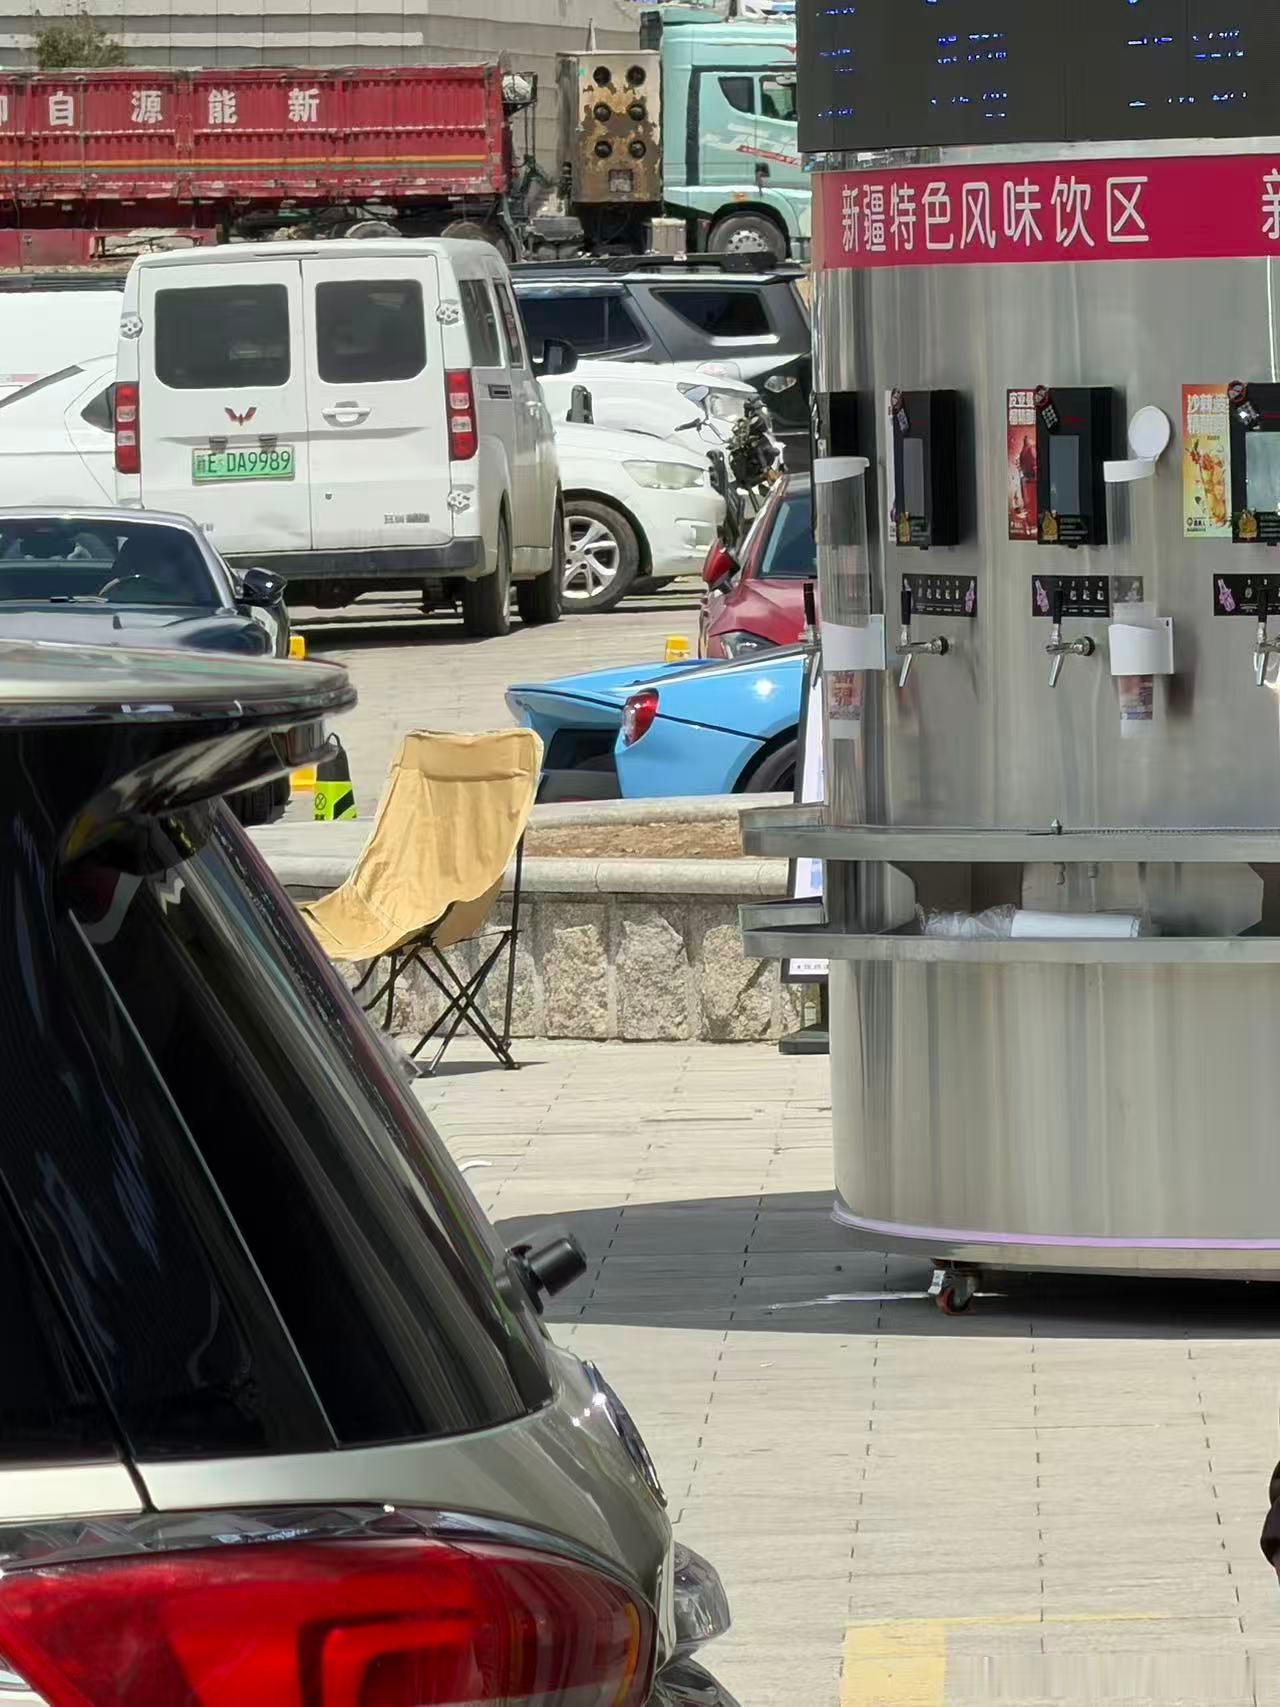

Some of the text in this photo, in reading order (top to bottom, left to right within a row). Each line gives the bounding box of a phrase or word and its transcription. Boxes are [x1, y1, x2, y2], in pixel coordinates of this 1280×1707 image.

[841, 175, 1150, 252] 新疆特色风味饮区
